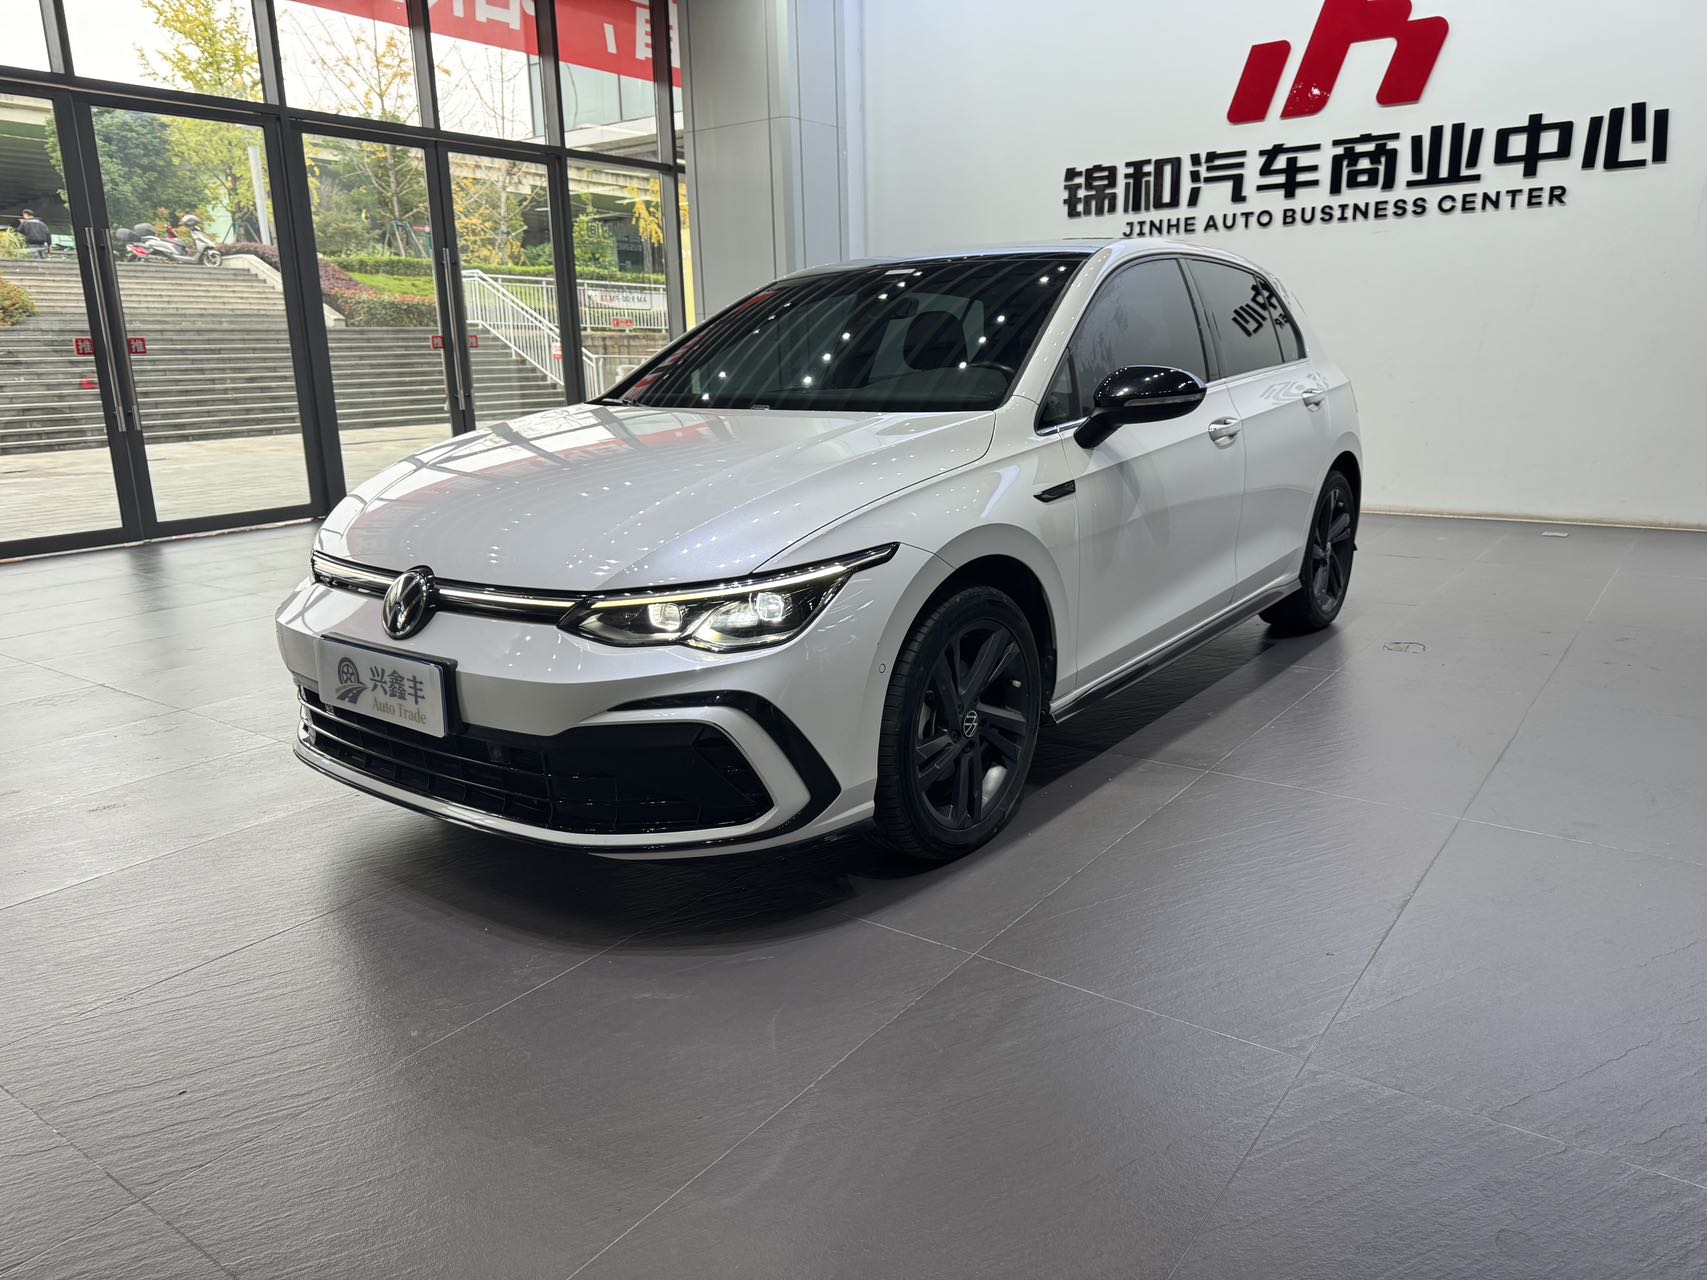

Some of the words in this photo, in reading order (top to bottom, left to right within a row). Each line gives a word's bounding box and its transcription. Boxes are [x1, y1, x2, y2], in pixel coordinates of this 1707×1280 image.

[1063, 102, 1669, 218] 锦和汽车商业中心
[1122, 216, 1196, 237] JINHE
[1203, 210, 1273, 232] AUTO
[1282, 197, 1427, 225] BUSINESS
[1437, 185, 1567, 214] CENTER
[78, 339, 93, 353] 推
[131, 339, 145, 352] 推
[369, 665, 425, 704] 兴鑫丰
[373, 698, 395, 716] Auto
[399, 702, 427, 725] Trade
